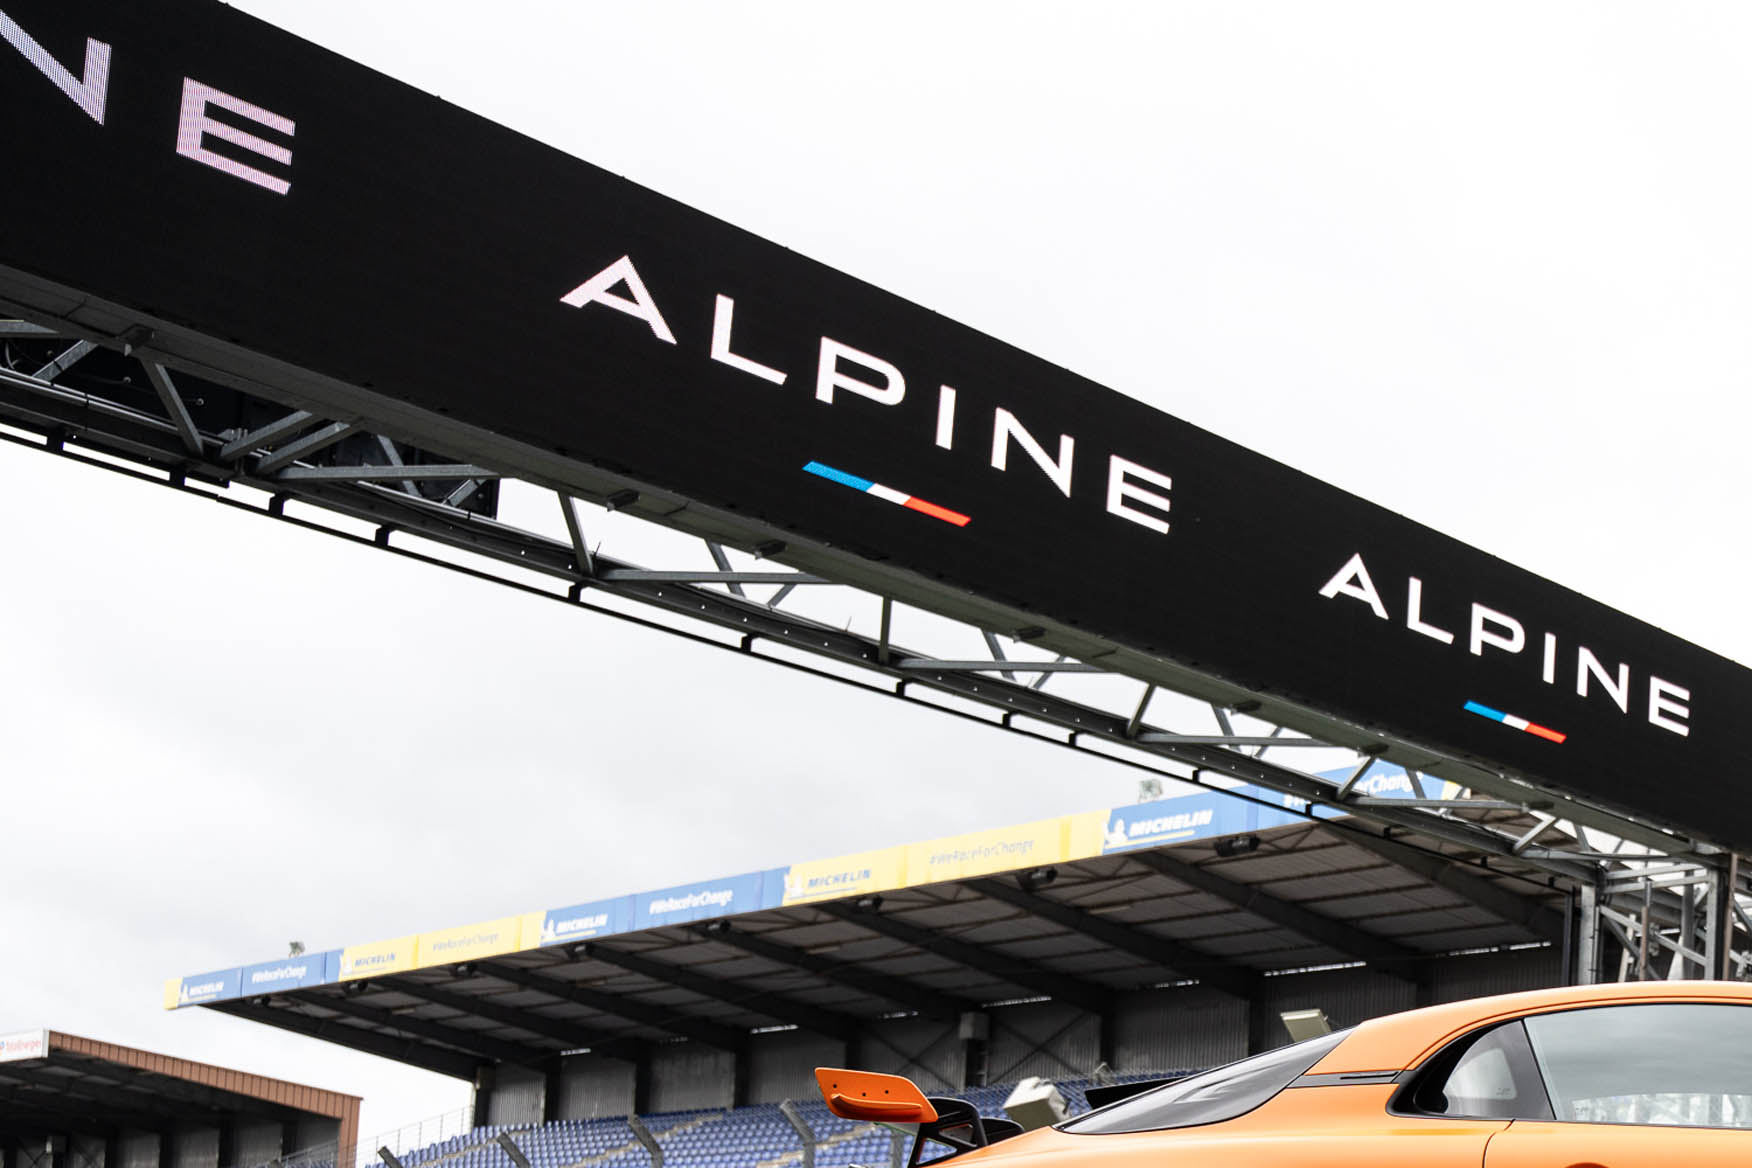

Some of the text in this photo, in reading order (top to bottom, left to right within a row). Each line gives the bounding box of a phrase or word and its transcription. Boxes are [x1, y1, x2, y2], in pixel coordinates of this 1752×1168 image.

[560, 254, 1173, 535] ALPINE
[1318, 552, 1690, 737] ALPINE
[1129, 810, 1213, 837] MICHELIN
[807, 868, 872, 888] MICHELIN
[555, 914, 608, 934] MICHELIN
